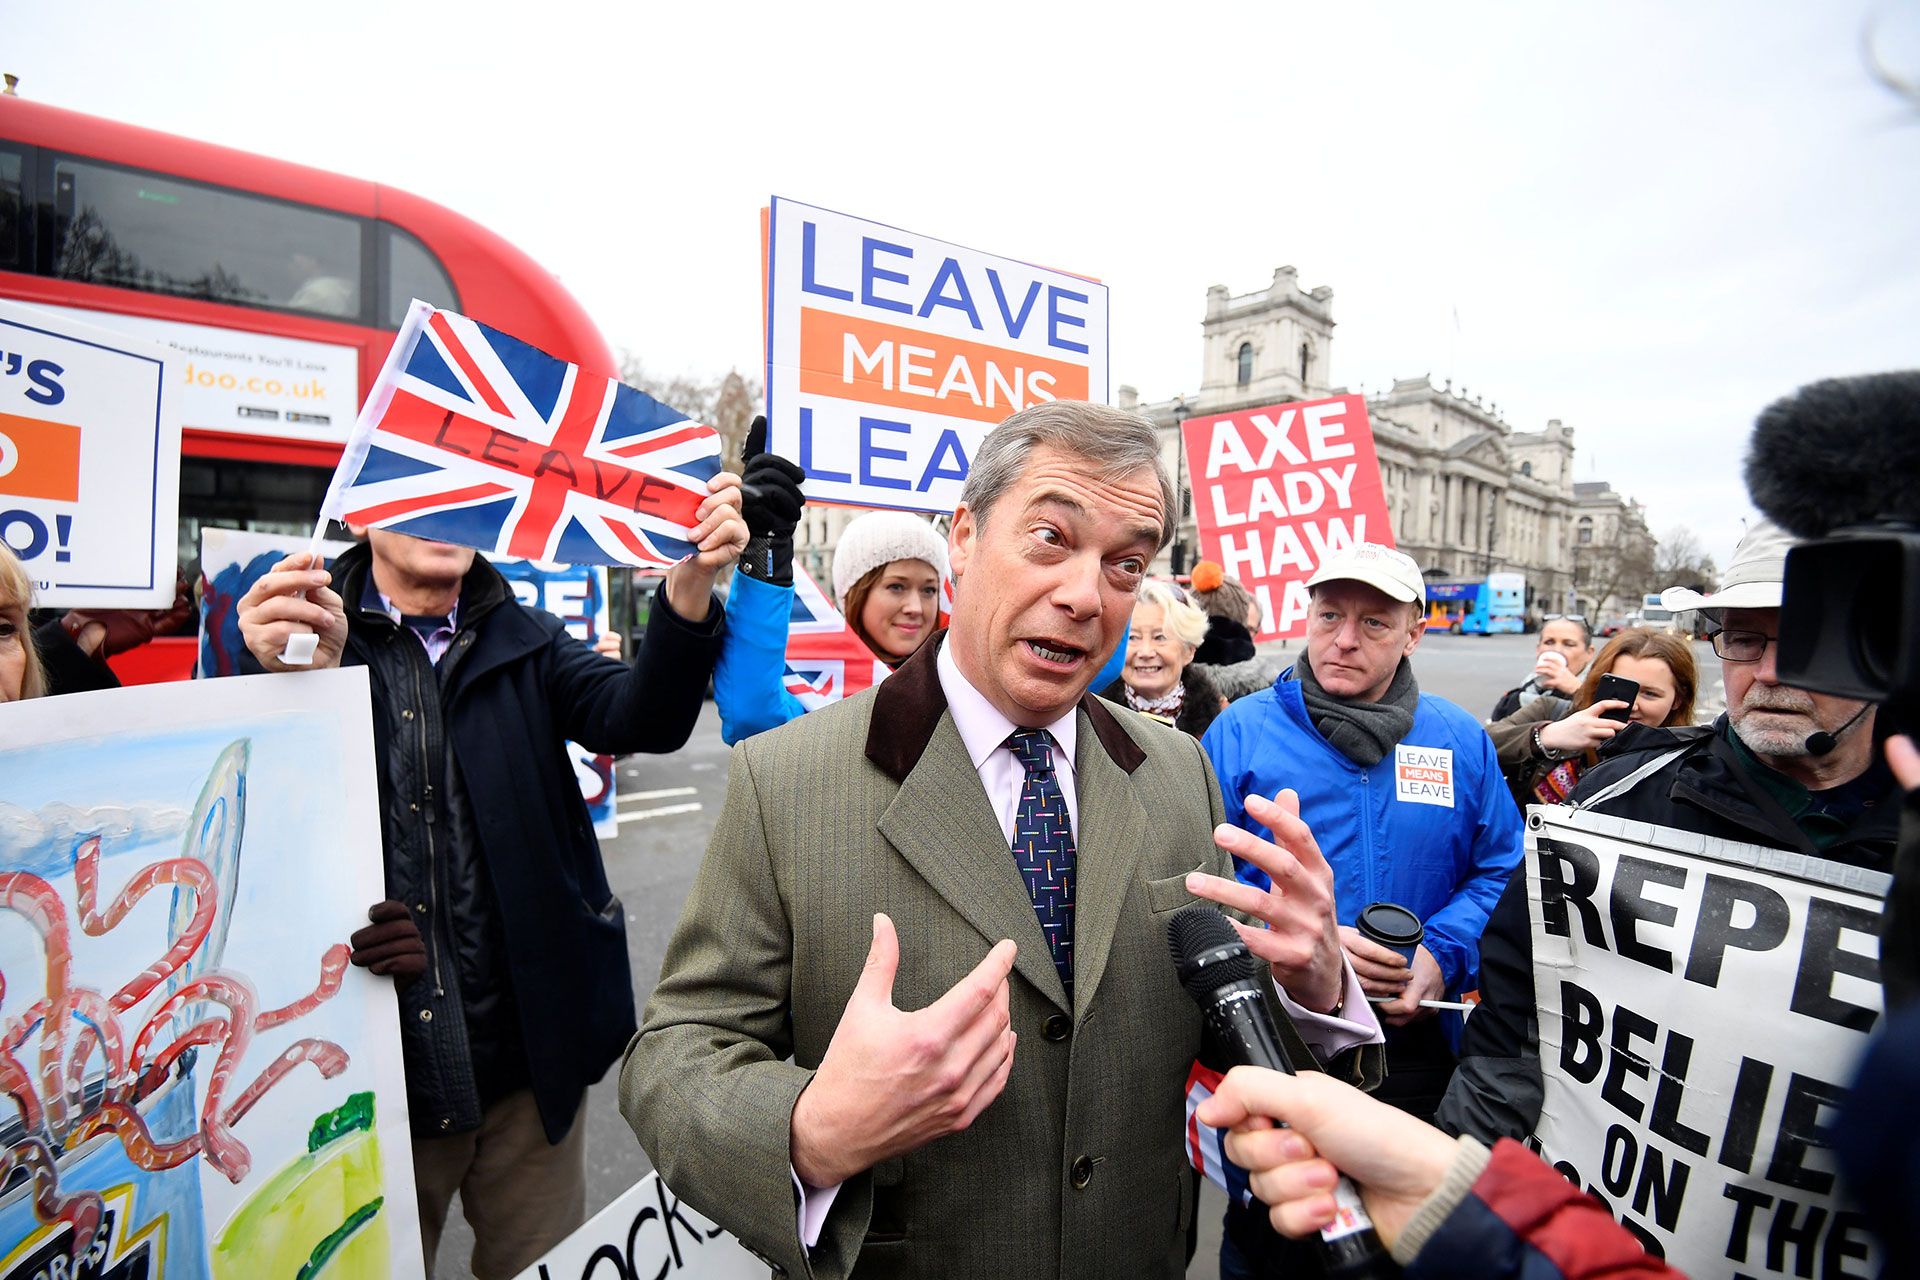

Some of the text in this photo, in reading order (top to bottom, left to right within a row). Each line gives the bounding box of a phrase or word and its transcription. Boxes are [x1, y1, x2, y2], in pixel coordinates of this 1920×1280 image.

[801, 221, 1090, 355] LEAVE
[0, 352, 66, 406] 'S
[843, 332, 1057, 411] MEANS
[434, 409, 676, 520] LEAVE
[799, 407, 988, 493] LEA
[1205, 402, 1356, 479] AXE
[1210, 463, 1358, 527] LADY
[1219, 514, 1367, 578] HAW
[1398, 751, 1448, 769] LEAVE
[1400, 782, 1451, 799] LEAVE
[1405, 767, 1444, 782] MEANS
[1536, 837, 1881, 1034] REPE
[1601, 1123, 1691, 1234] ON
[1722, 1182, 1870, 1280] THE
